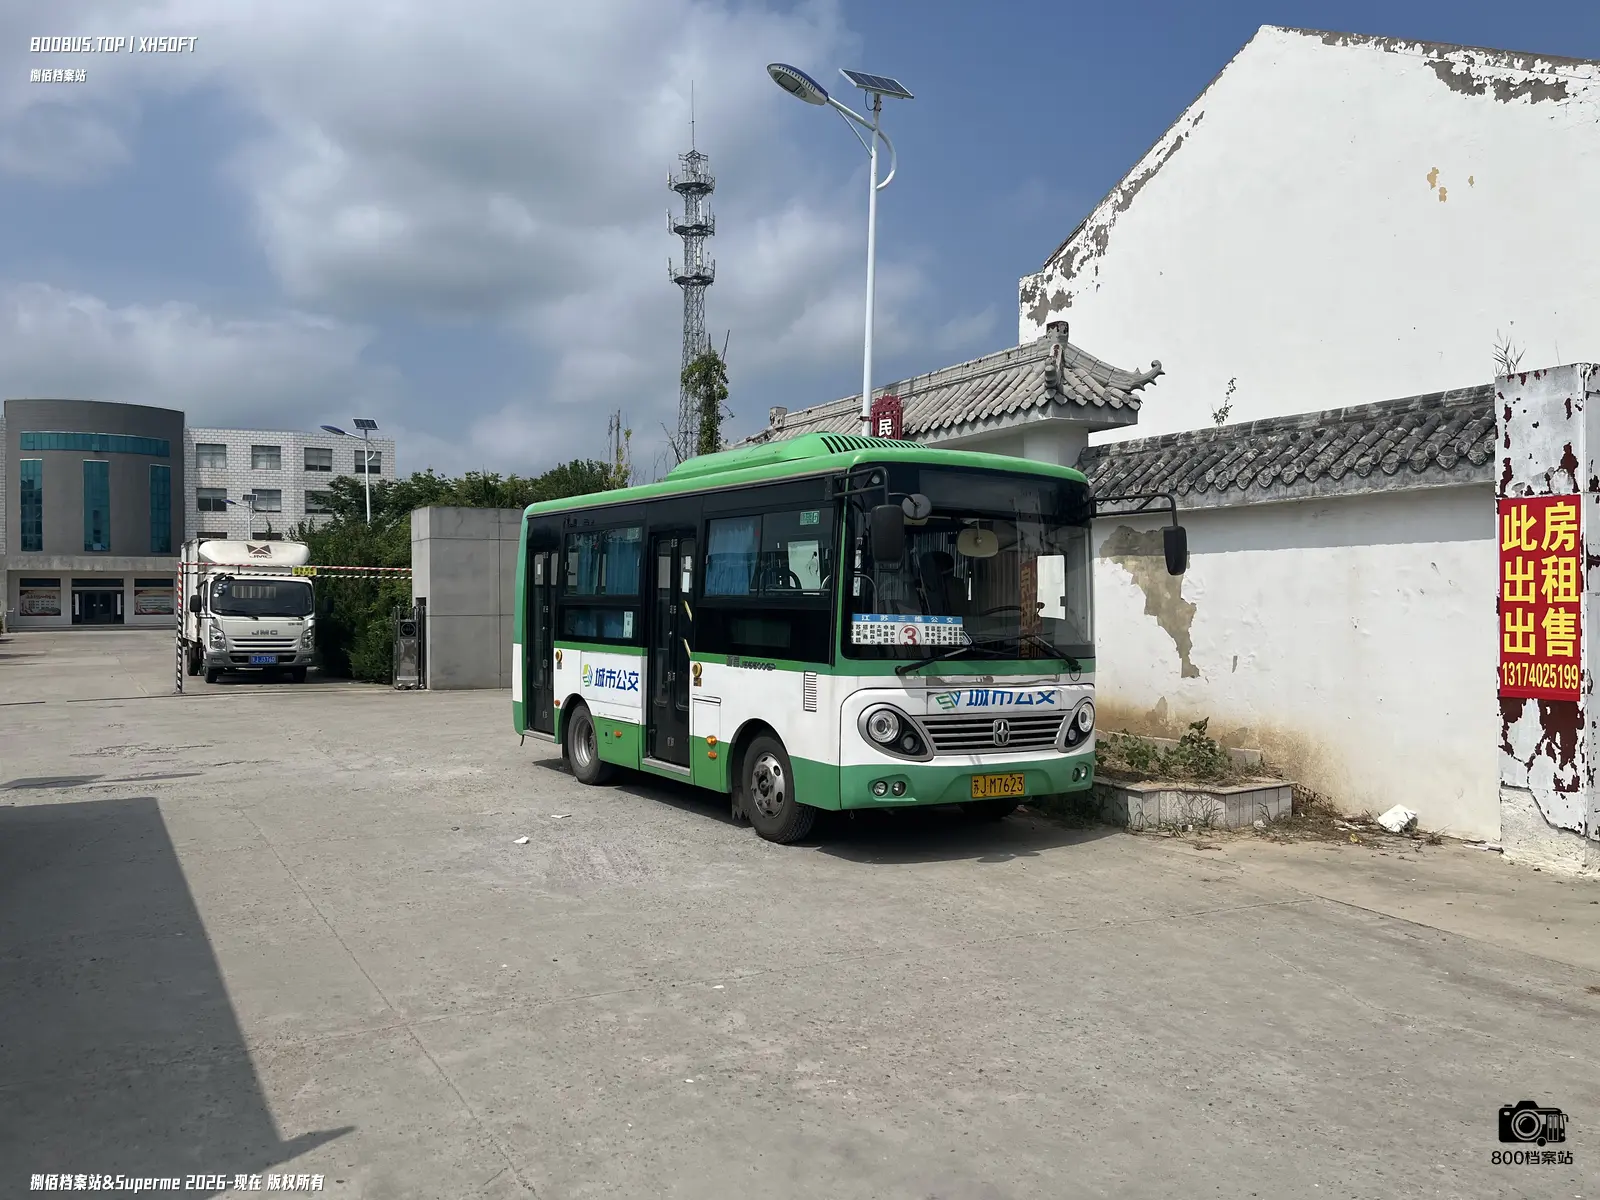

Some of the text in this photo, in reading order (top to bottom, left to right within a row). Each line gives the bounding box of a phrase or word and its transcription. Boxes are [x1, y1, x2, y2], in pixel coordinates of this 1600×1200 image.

[1501, 501, 1578, 552] 此房
[1503, 554, 1579, 604] 出租
[904, 627, 917, 645] 3
[1503, 606, 1577, 657] 出售
[594, 667, 640, 692] 城市公交
[1502, 661, 1579, 689] 13174025199
